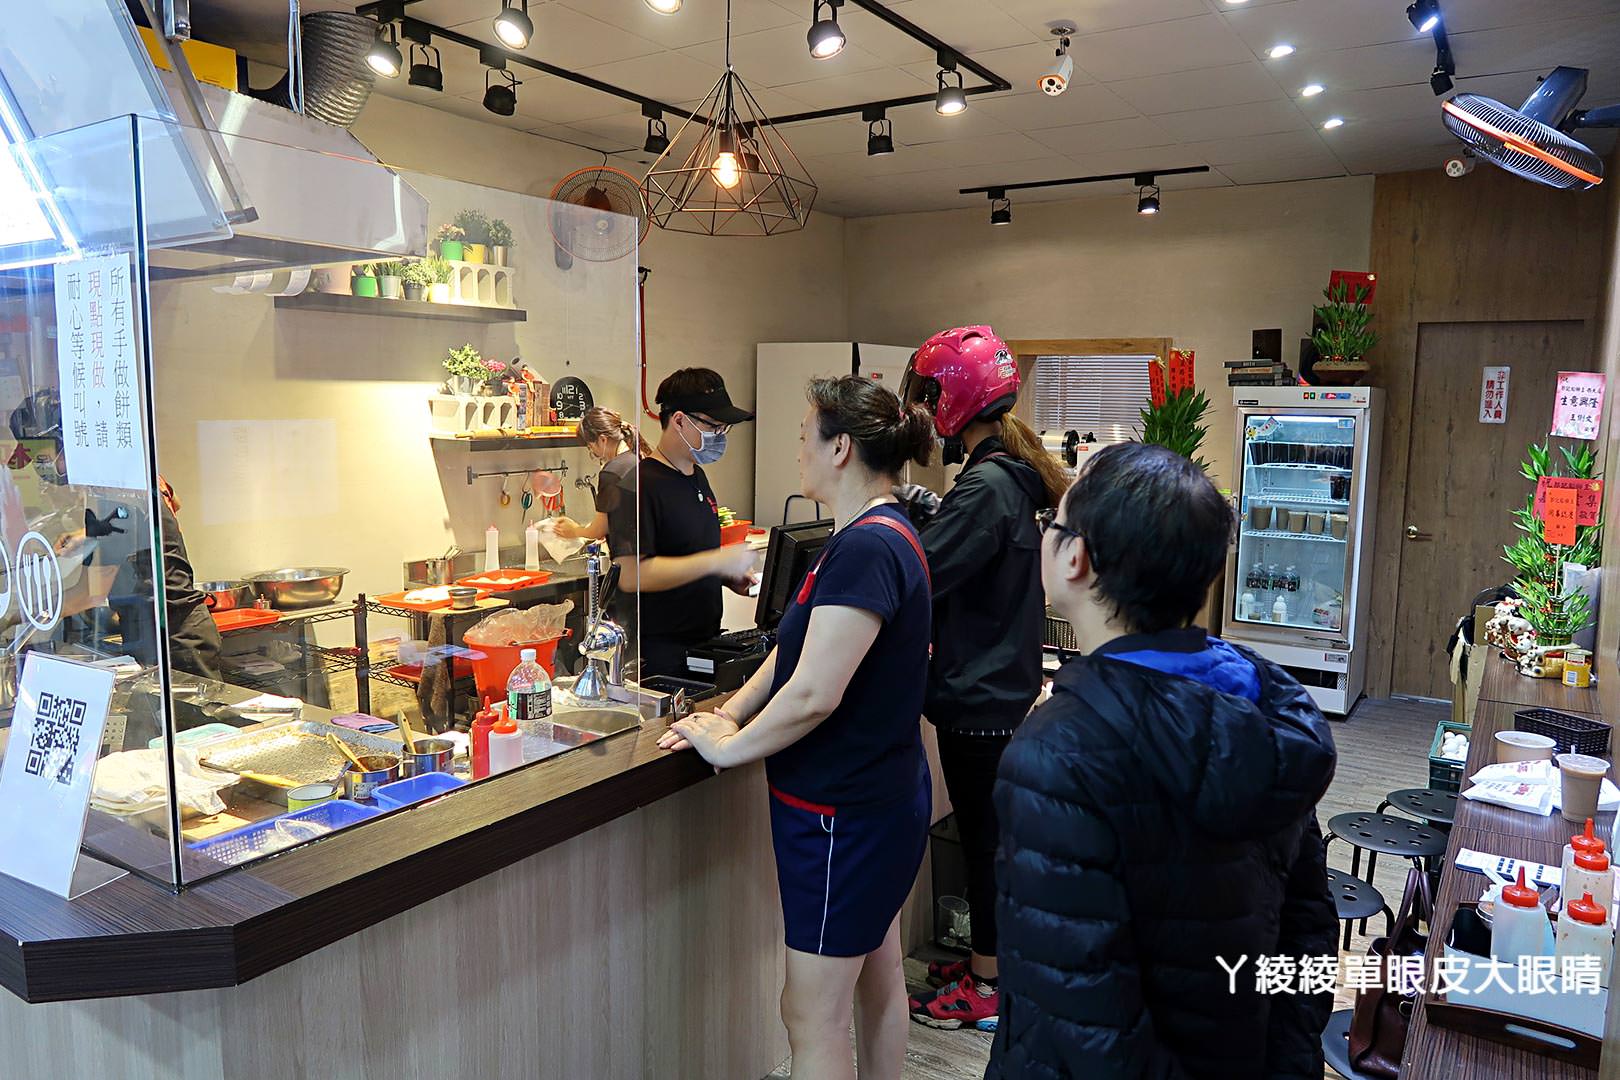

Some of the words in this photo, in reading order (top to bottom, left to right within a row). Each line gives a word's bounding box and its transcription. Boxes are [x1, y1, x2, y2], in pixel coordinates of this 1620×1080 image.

[66, 272, 89, 448] 耐心等候叫號
[87, 270, 108, 448] 現點現做，請
[109, 266, 133, 448] 所有手做餅類
[556, 401, 562, 410] 9
[1483, 380, 1495, 418] 請勿進入
[1493, 370, 1505, 419] 非工作人員
[1560, 395, 1599, 408] 生意興隆
